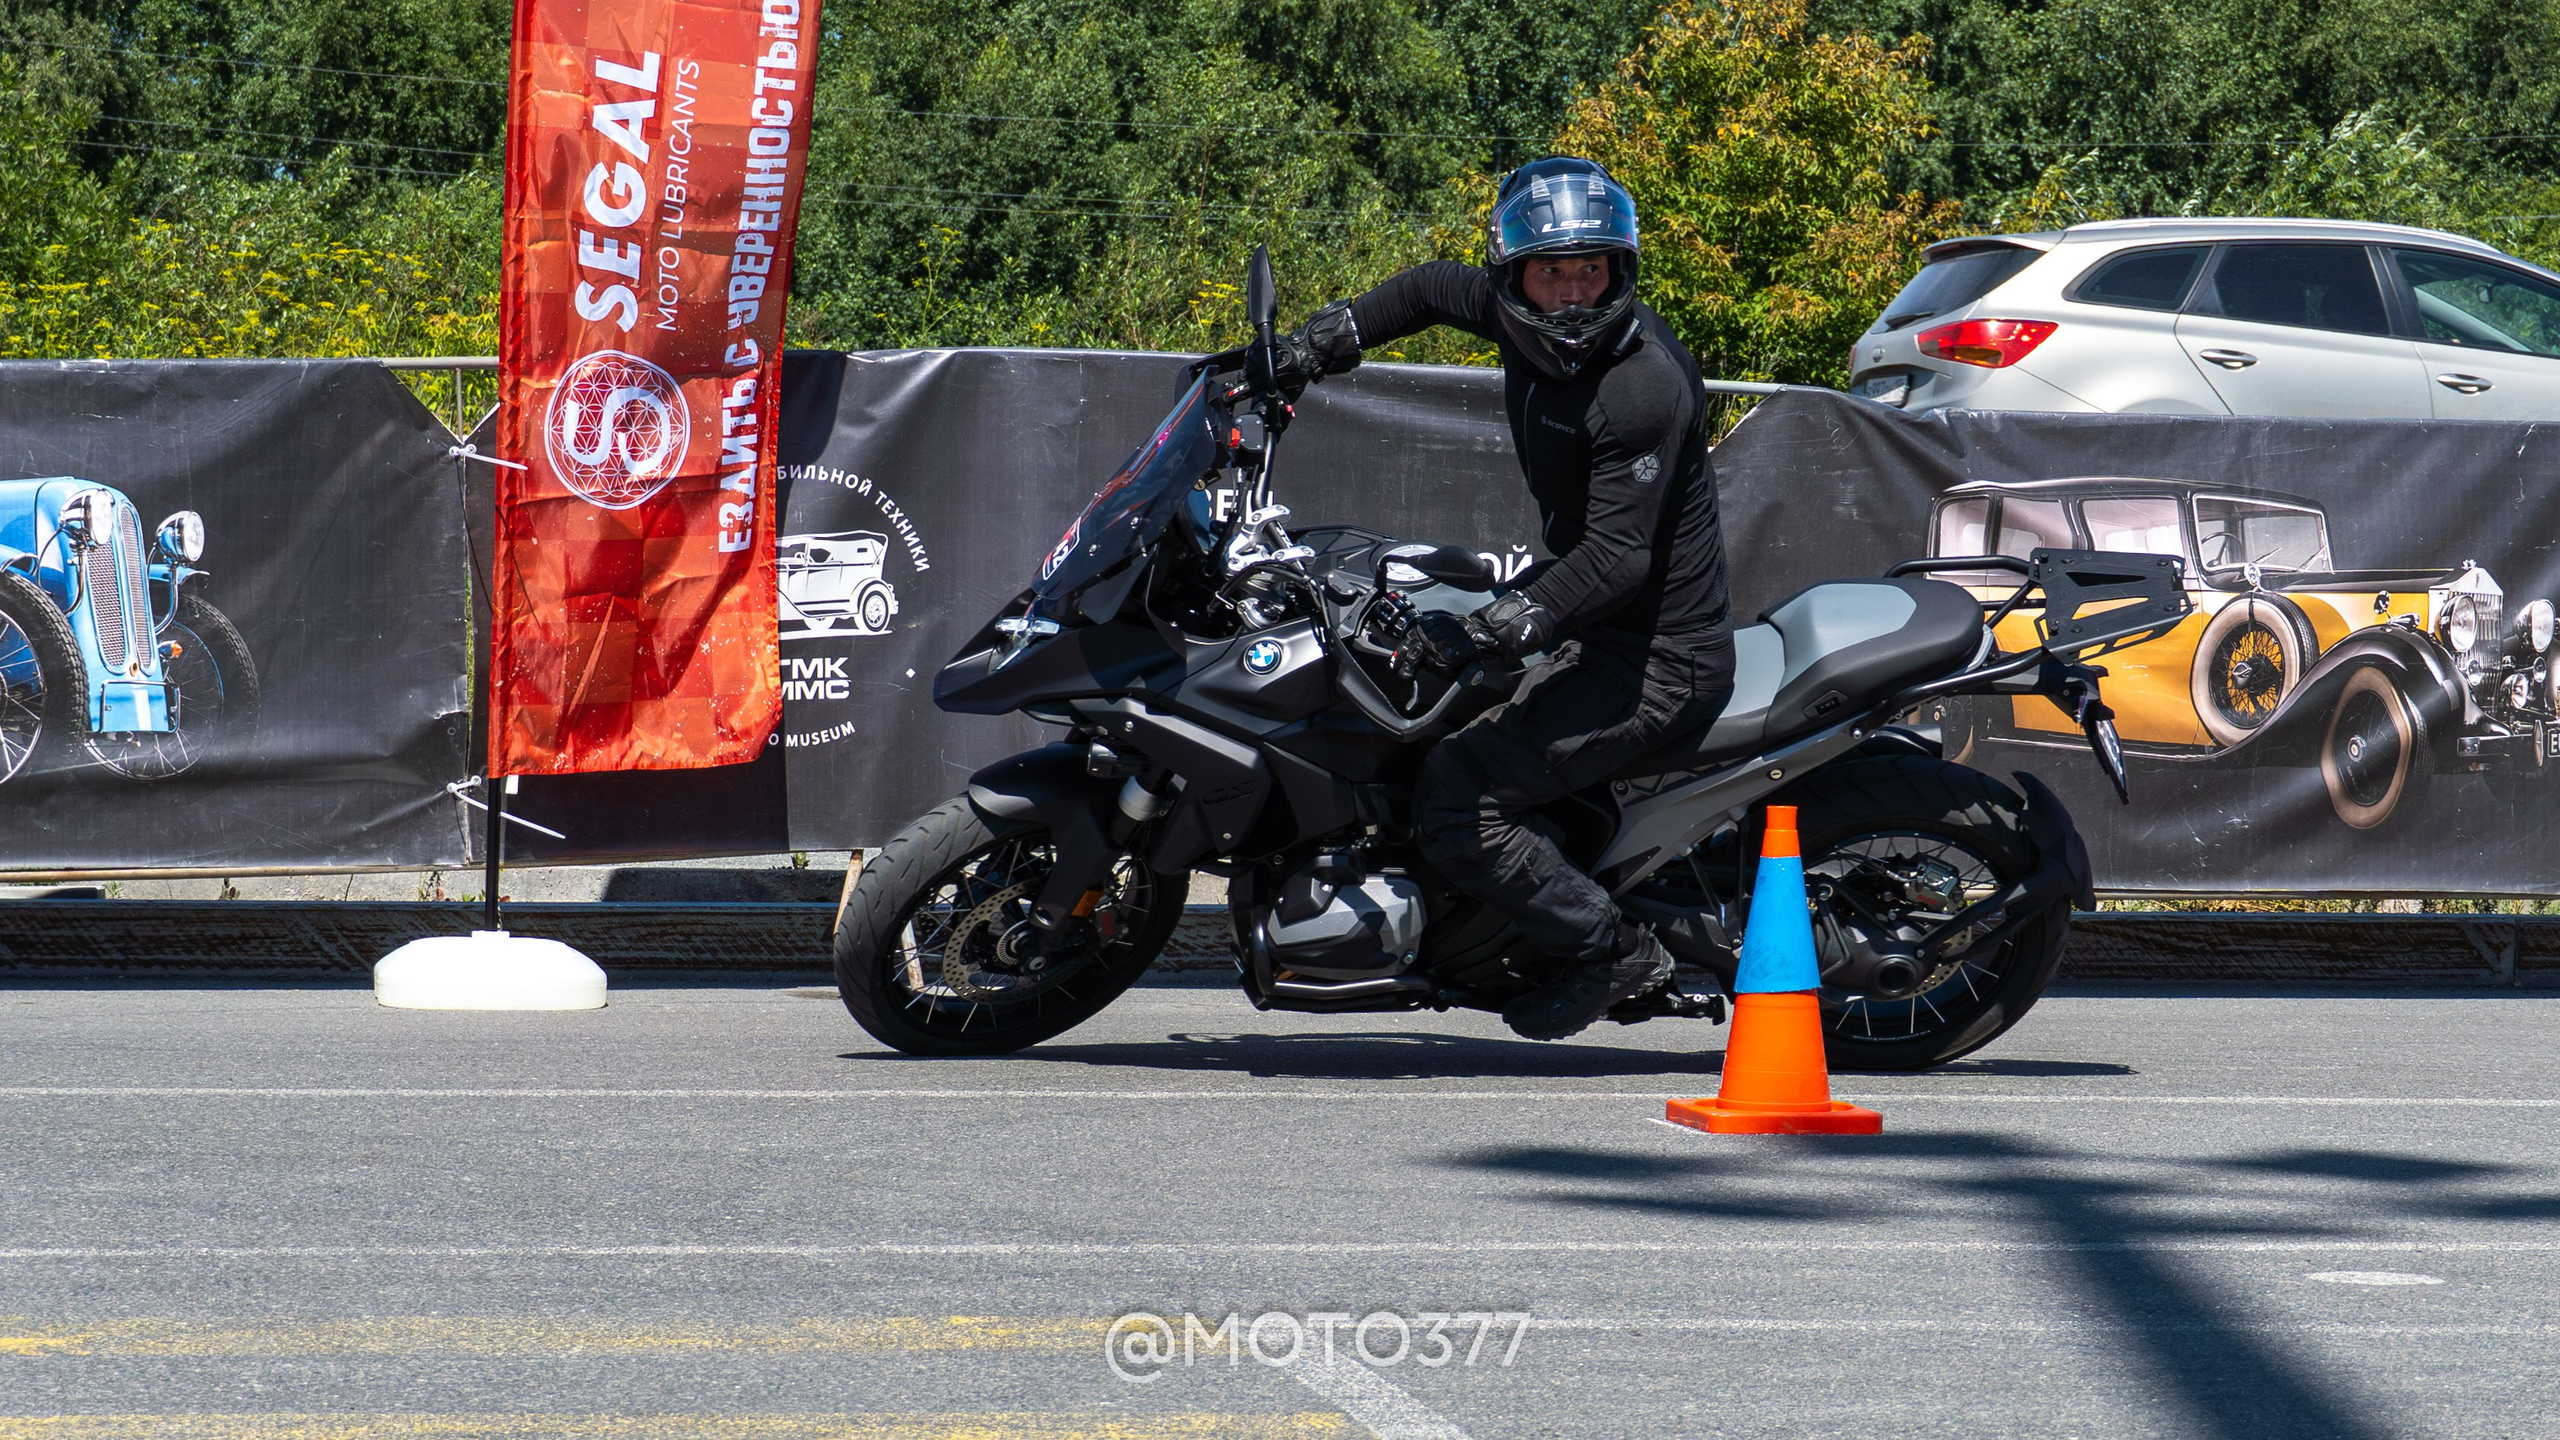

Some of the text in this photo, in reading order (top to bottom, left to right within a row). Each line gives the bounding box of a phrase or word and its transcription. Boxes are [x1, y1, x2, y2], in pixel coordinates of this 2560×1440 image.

[575, 50, 661, 334] SEGAL
[656, 58, 701, 331] MOTO LUBRICANTS
[718, 0, 801, 554] ЕЗДИТЬ С УВЕРЕННОСТЬЮ
[1541, 219, 1601, 233] LS2
[776, 464, 930, 572] БИЛЬНОЙ ТЕХНИКИ
[785, 720, 856, 748] MUSEUM
